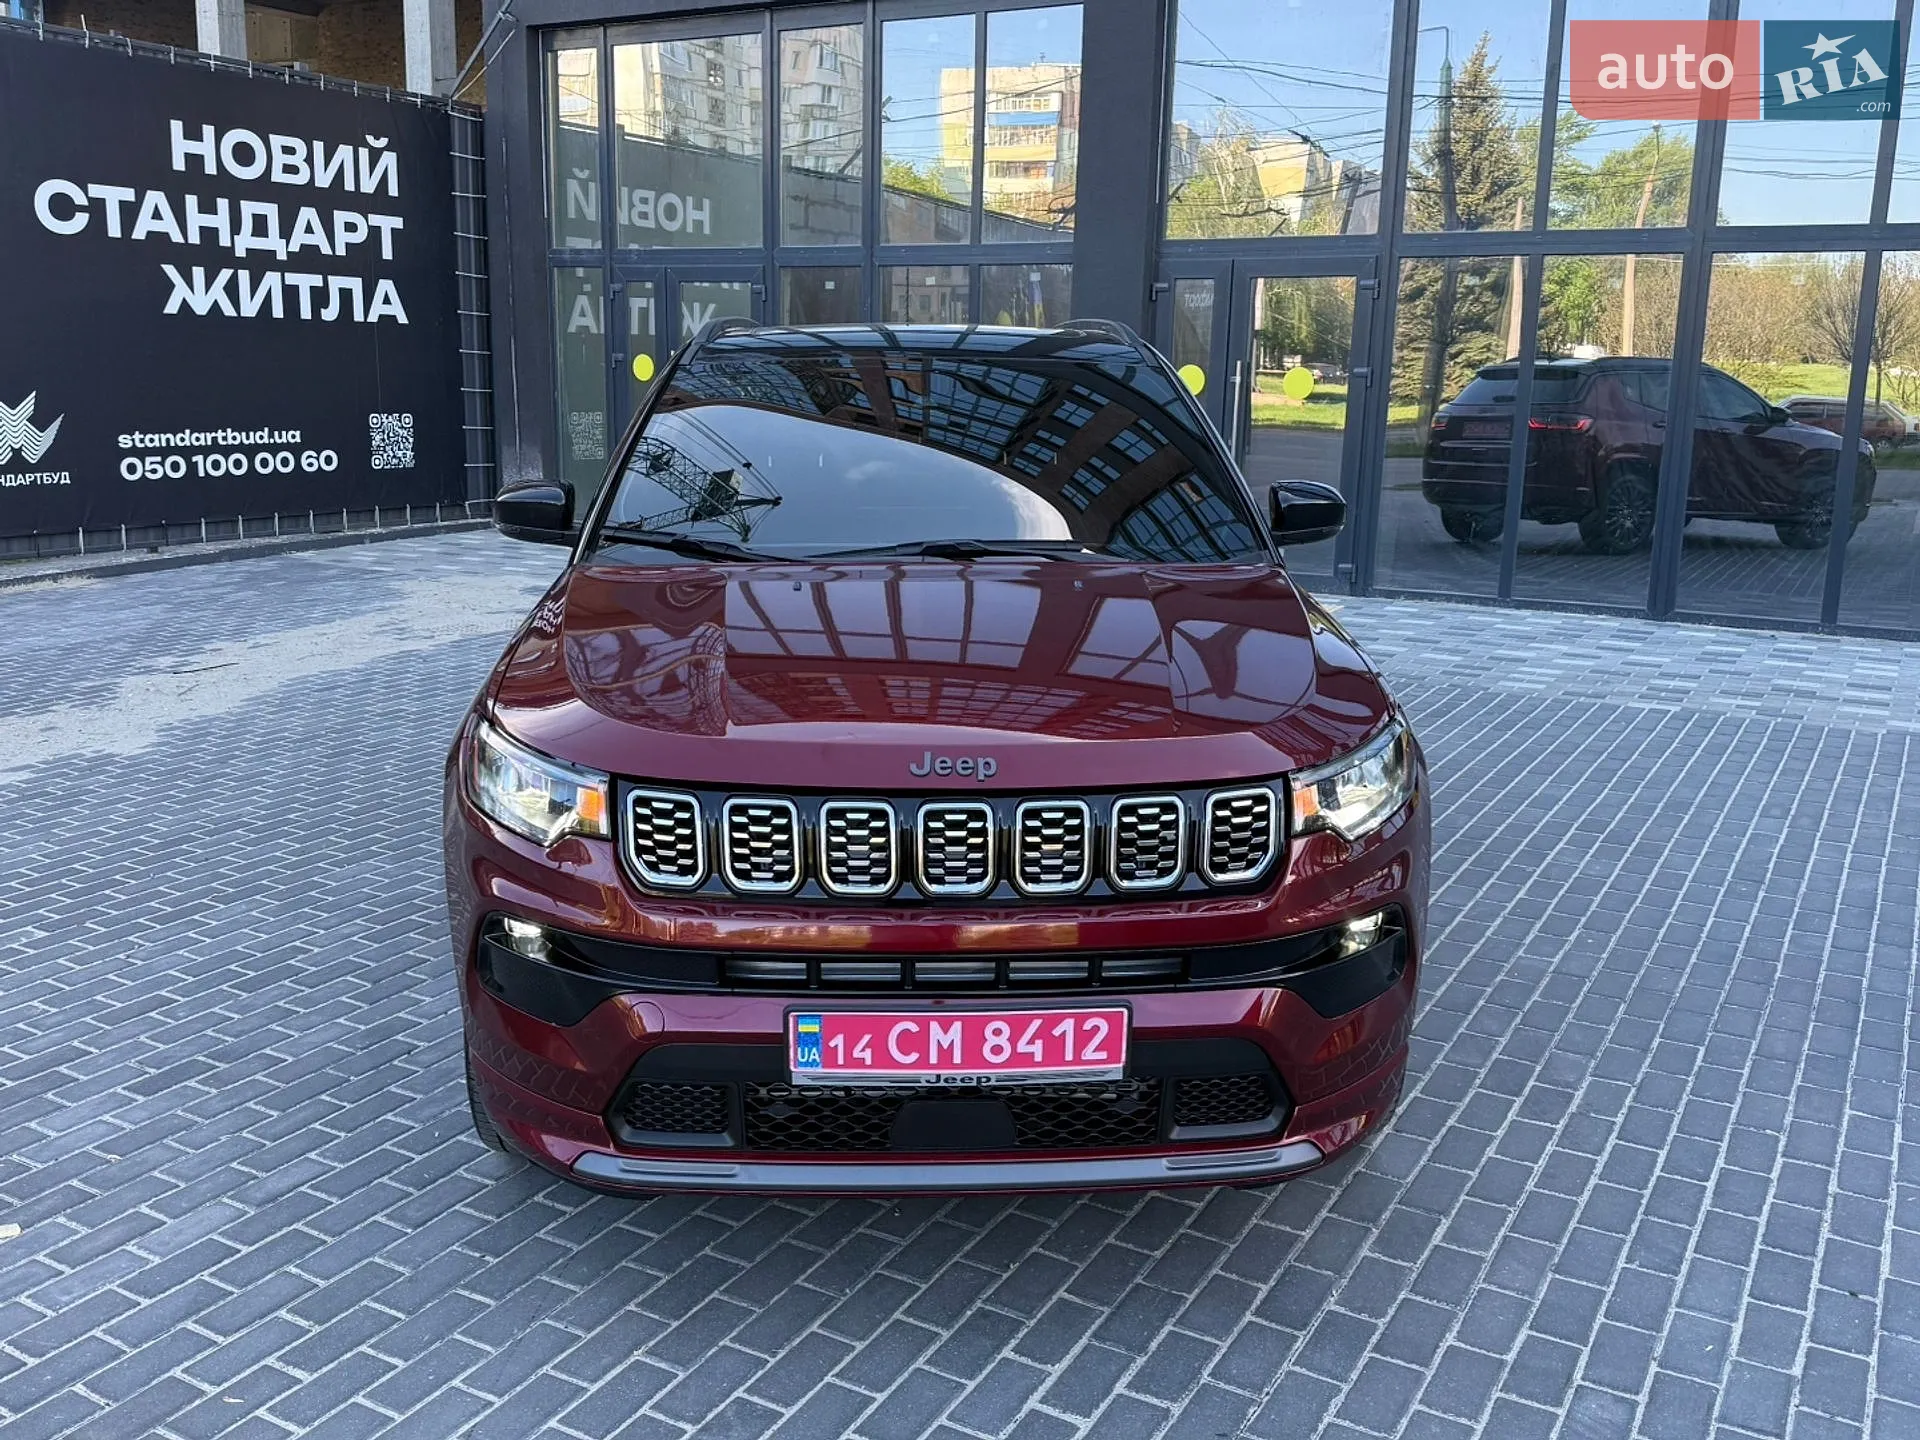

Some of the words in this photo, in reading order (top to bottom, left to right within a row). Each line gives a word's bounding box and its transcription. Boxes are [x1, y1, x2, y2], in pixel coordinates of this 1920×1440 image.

[169, 119, 400, 198] НОВИЙ
[33, 178, 404, 261] СТАНДАРТ
[160, 264, 410, 324] ЖИТЛА
[117, 427, 302, 448] standartbud.ua
[119, 454, 187, 481] 050
[191, 453, 249, 478] 100
[254, 450, 295, 475] 00
[300, 449, 339, 472] 60
[909, 751, 998, 782] Jeep
[797, 1046, 820, 1063] UA
[828, 1034, 873, 1066] 14
[887, 1020, 963, 1065] CM
[982, 1017, 1110, 1063] 8412
[925, 1074, 992, 1086] Jeep
